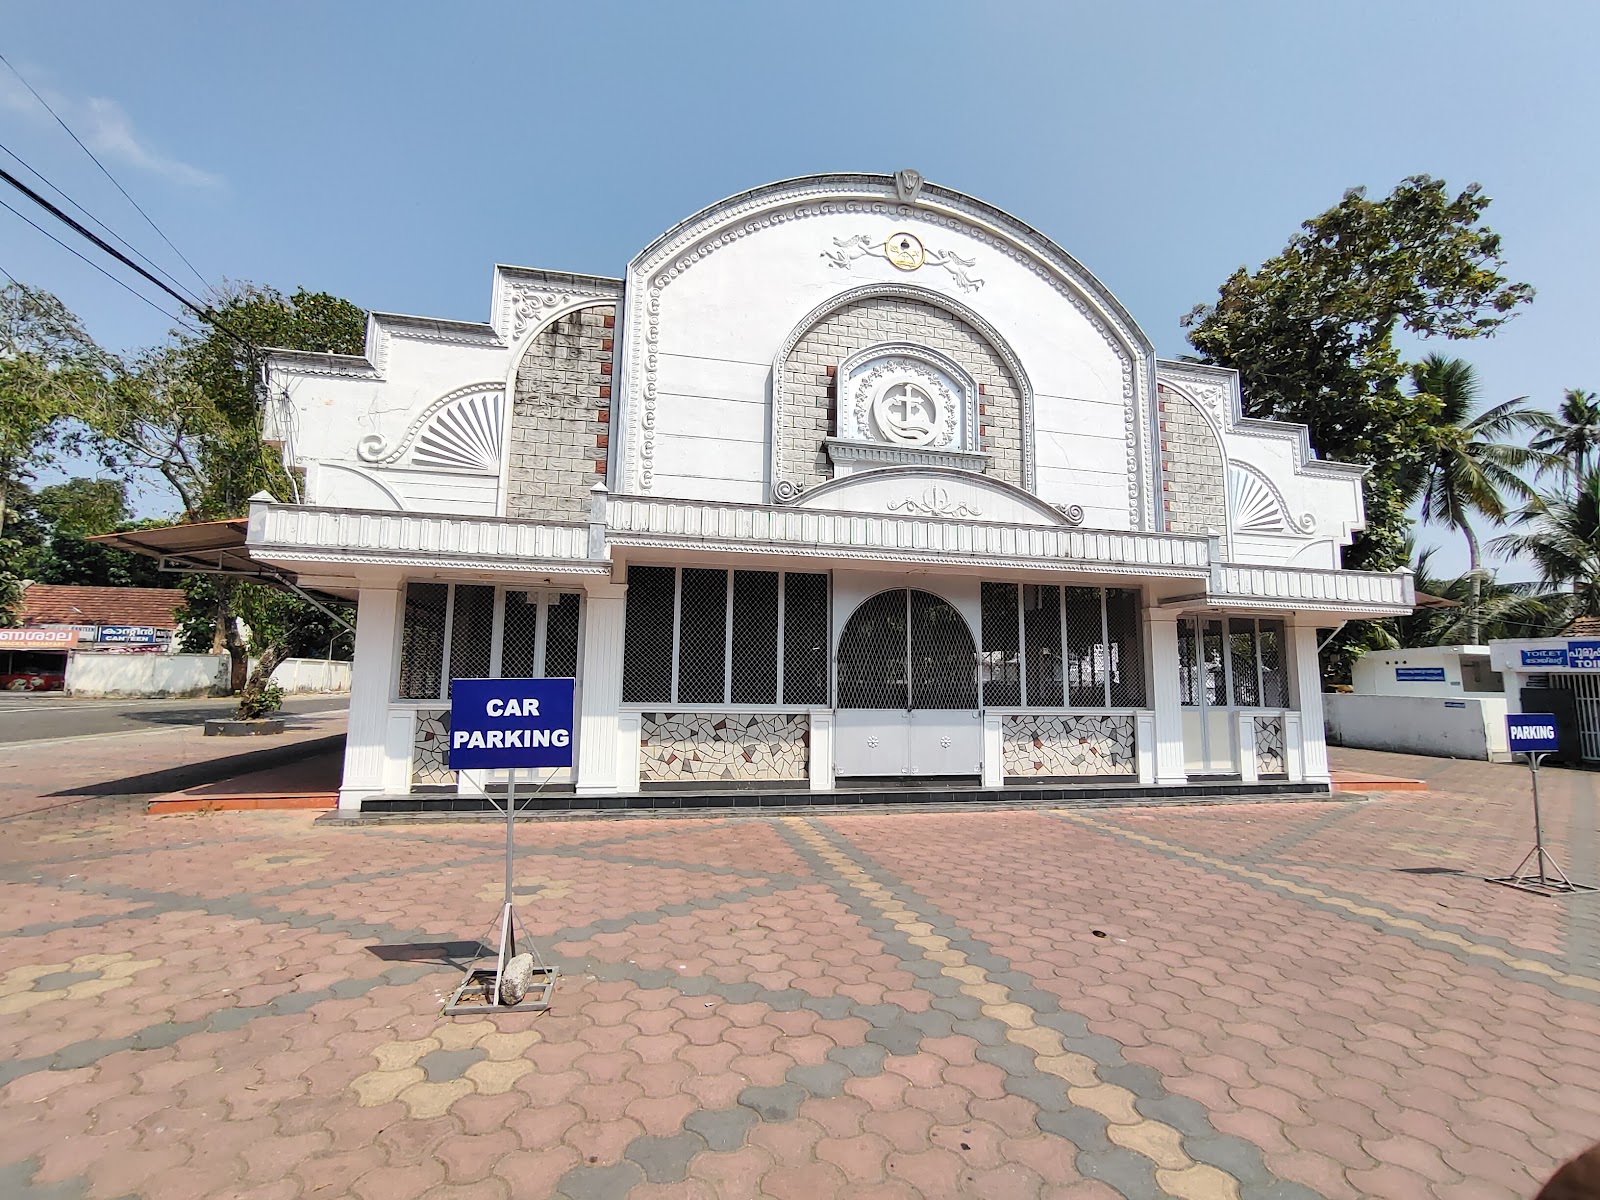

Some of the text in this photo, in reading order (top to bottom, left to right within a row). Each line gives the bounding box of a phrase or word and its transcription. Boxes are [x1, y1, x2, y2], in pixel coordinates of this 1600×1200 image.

[486, 699, 540, 717] CAR
[453, 729, 570, 749] PARKING
[1510, 725, 1555, 740] PARKING
